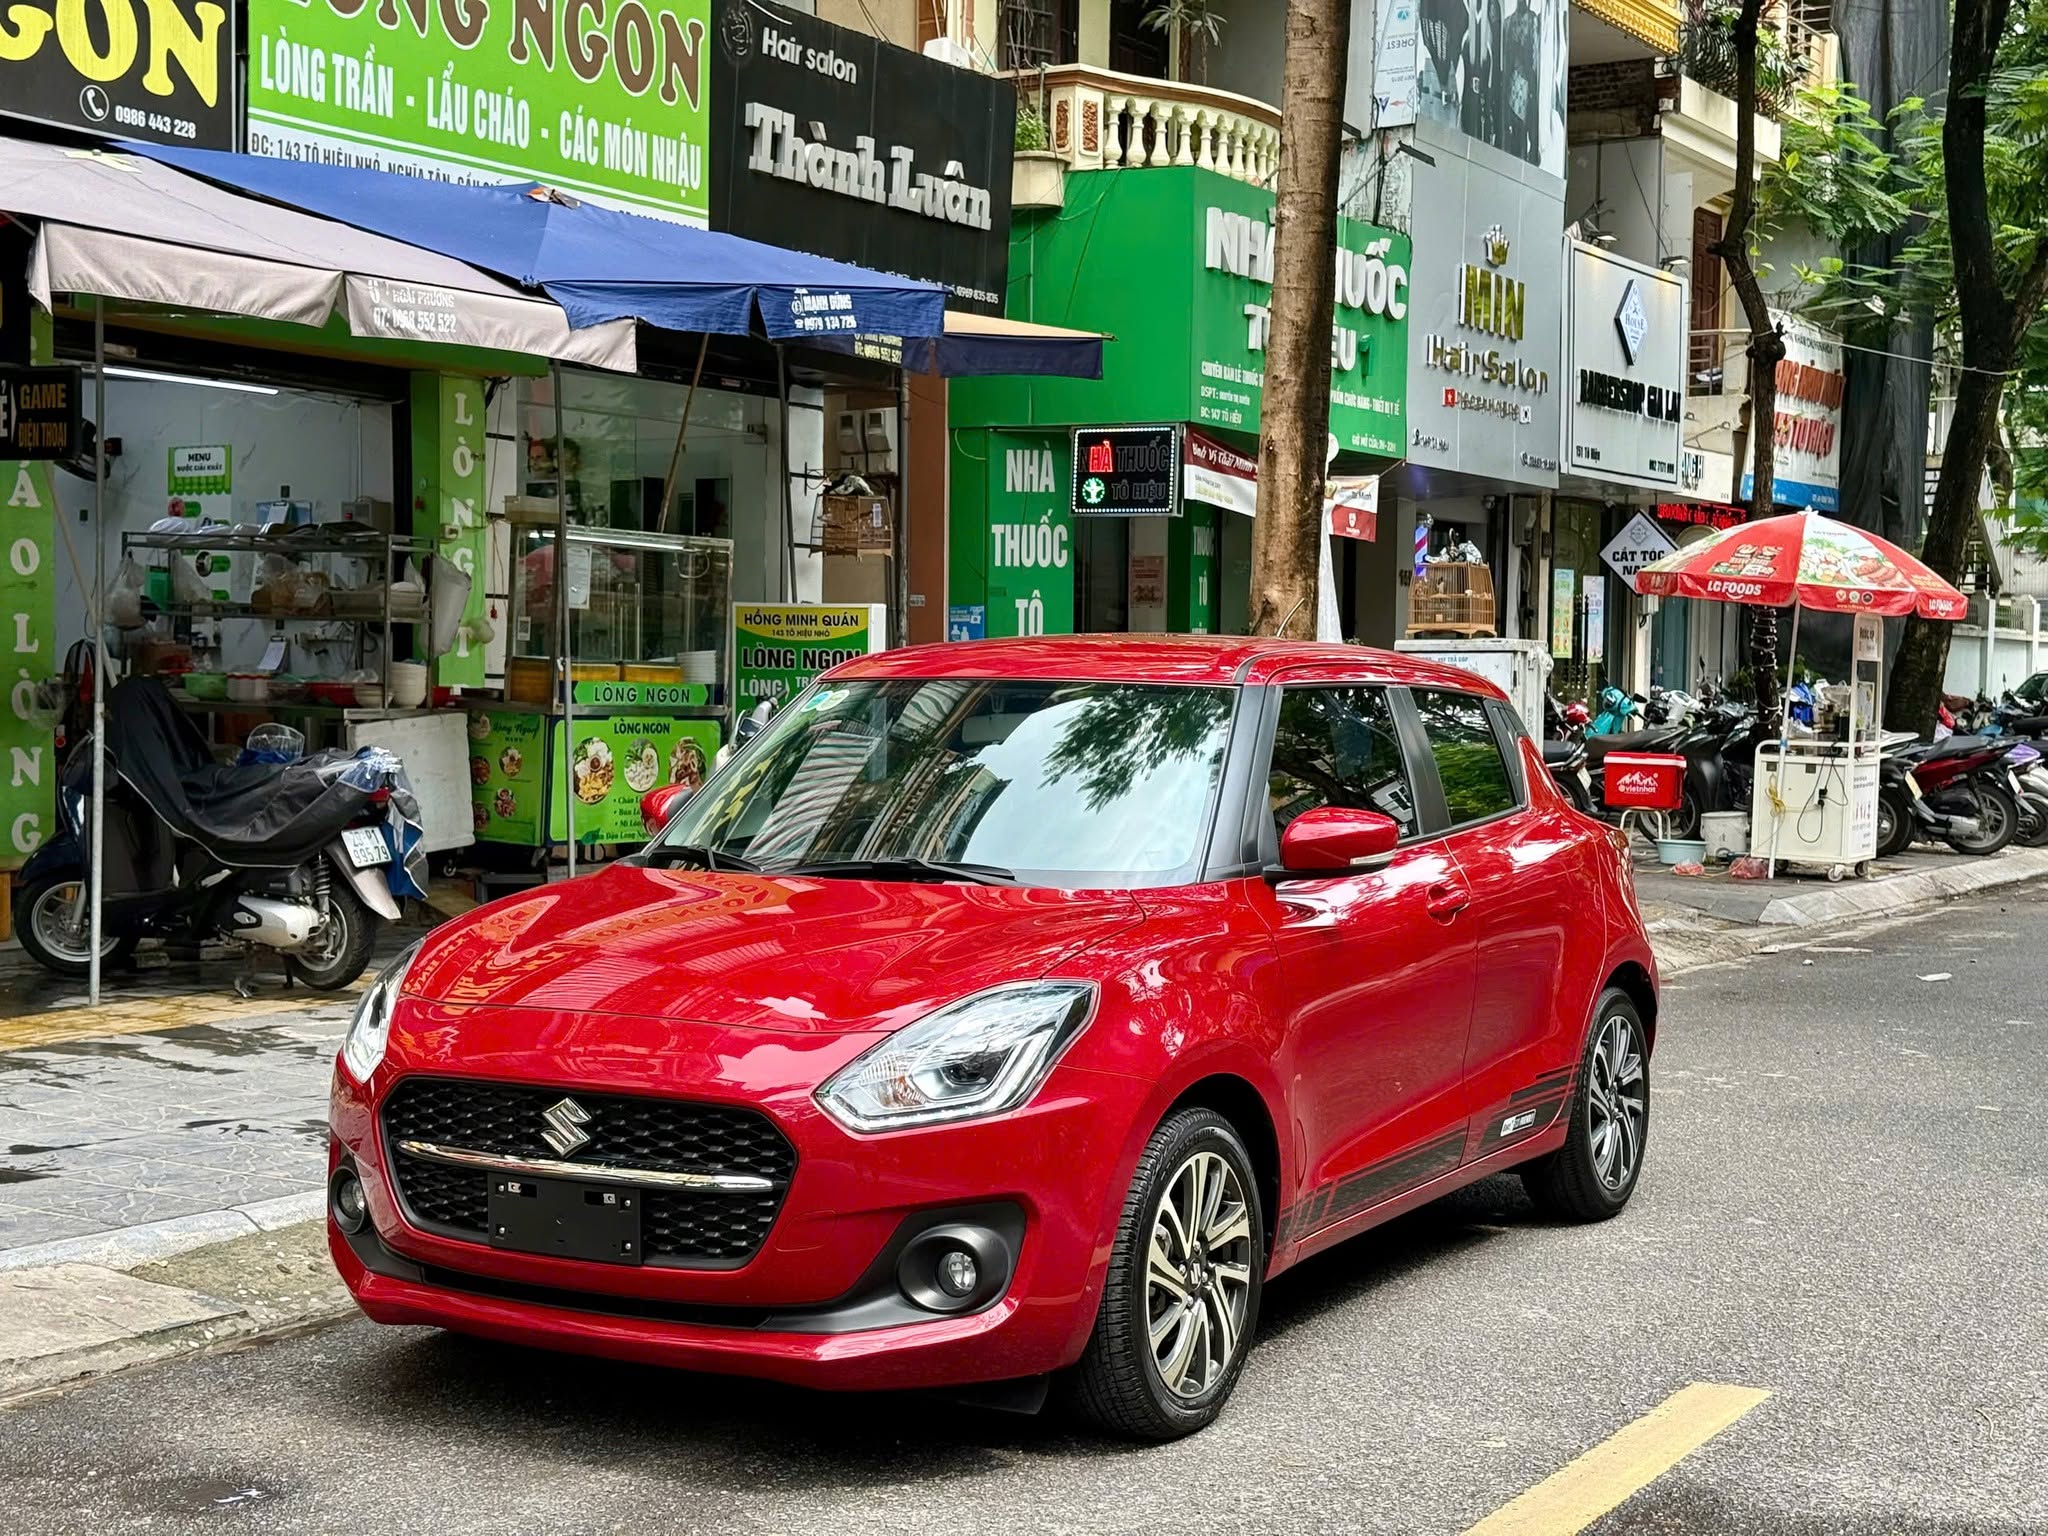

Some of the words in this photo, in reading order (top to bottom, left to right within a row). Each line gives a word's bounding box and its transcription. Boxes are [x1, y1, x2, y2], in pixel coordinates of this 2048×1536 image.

[761, 26, 803, 66] Hair
[804, 47, 857, 85] salon
[115, 105, 146, 127] 0986
[148, 110, 172, 133] 443
[173, 115, 197, 139] 228
[260, 25, 326, 103] LÒNG
[331, 43, 394, 119] TRẦN
[473, 86, 530, 150] CHÁO
[559, 104, 599, 166] CÁC
[603, 117, 648, 178] MÓN
[651, 131, 702, 198] NHẬU
[251, 132, 273, 156] ĐC:
[278, 139, 301, 161] 143
[745, 101, 886, 204] Thành
[888, 145, 992, 231] Luân
[1459, 263, 1525, 341] MIN
[417, 311, 436, 331] 552
[437, 313, 456, 333] 522
[1426, 333, 1480, 376] Hair
[1483, 349, 1549, 393] Salon
[20, 384, 66, 409] GAME
[188, 453, 211, 462] MENU
[1005, 440, 1055, 493] NHÀ
[1079, 439, 1113, 473] NHÀ
[1116, 436, 1170, 472] THUỐC
[991, 508, 1068, 568] THUỐC
[1612, 546, 1638, 562] CẮT
[1640, 545, 1665, 562] TÓC
[785, 614, 818, 626] MINH
[822, 611, 859, 626] QUÁN
[1015, 589, 1044, 637] TÔ
[742, 642, 796, 670] LÒNG
[594, 682, 637, 702] LÒNG
[646, 687, 690, 703] NGON
[614, 718, 640, 735] LÒNG
[642, 722, 671, 735] NGON
